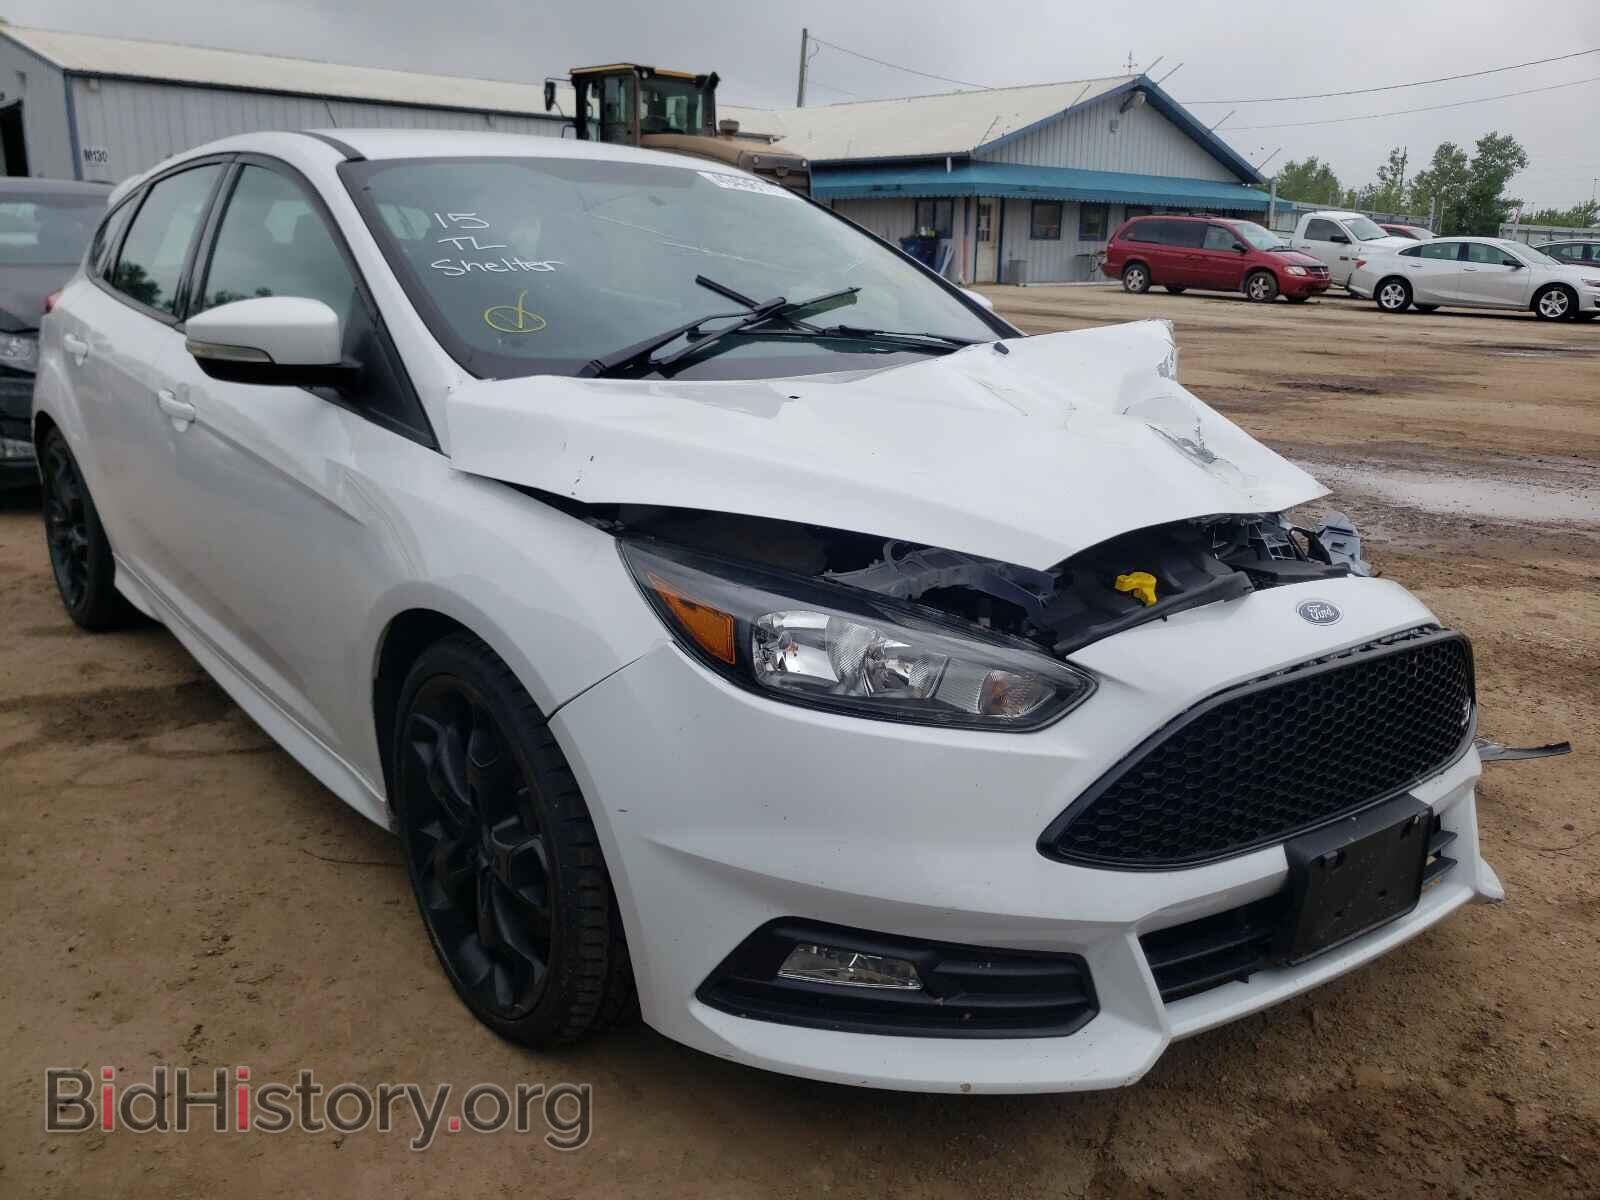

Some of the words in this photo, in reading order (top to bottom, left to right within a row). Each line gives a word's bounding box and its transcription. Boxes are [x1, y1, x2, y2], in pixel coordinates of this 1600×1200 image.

[433, 212, 490, 229] 15
[437, 236, 508, 250] TL
[430, 257, 565, 276] Shelter
